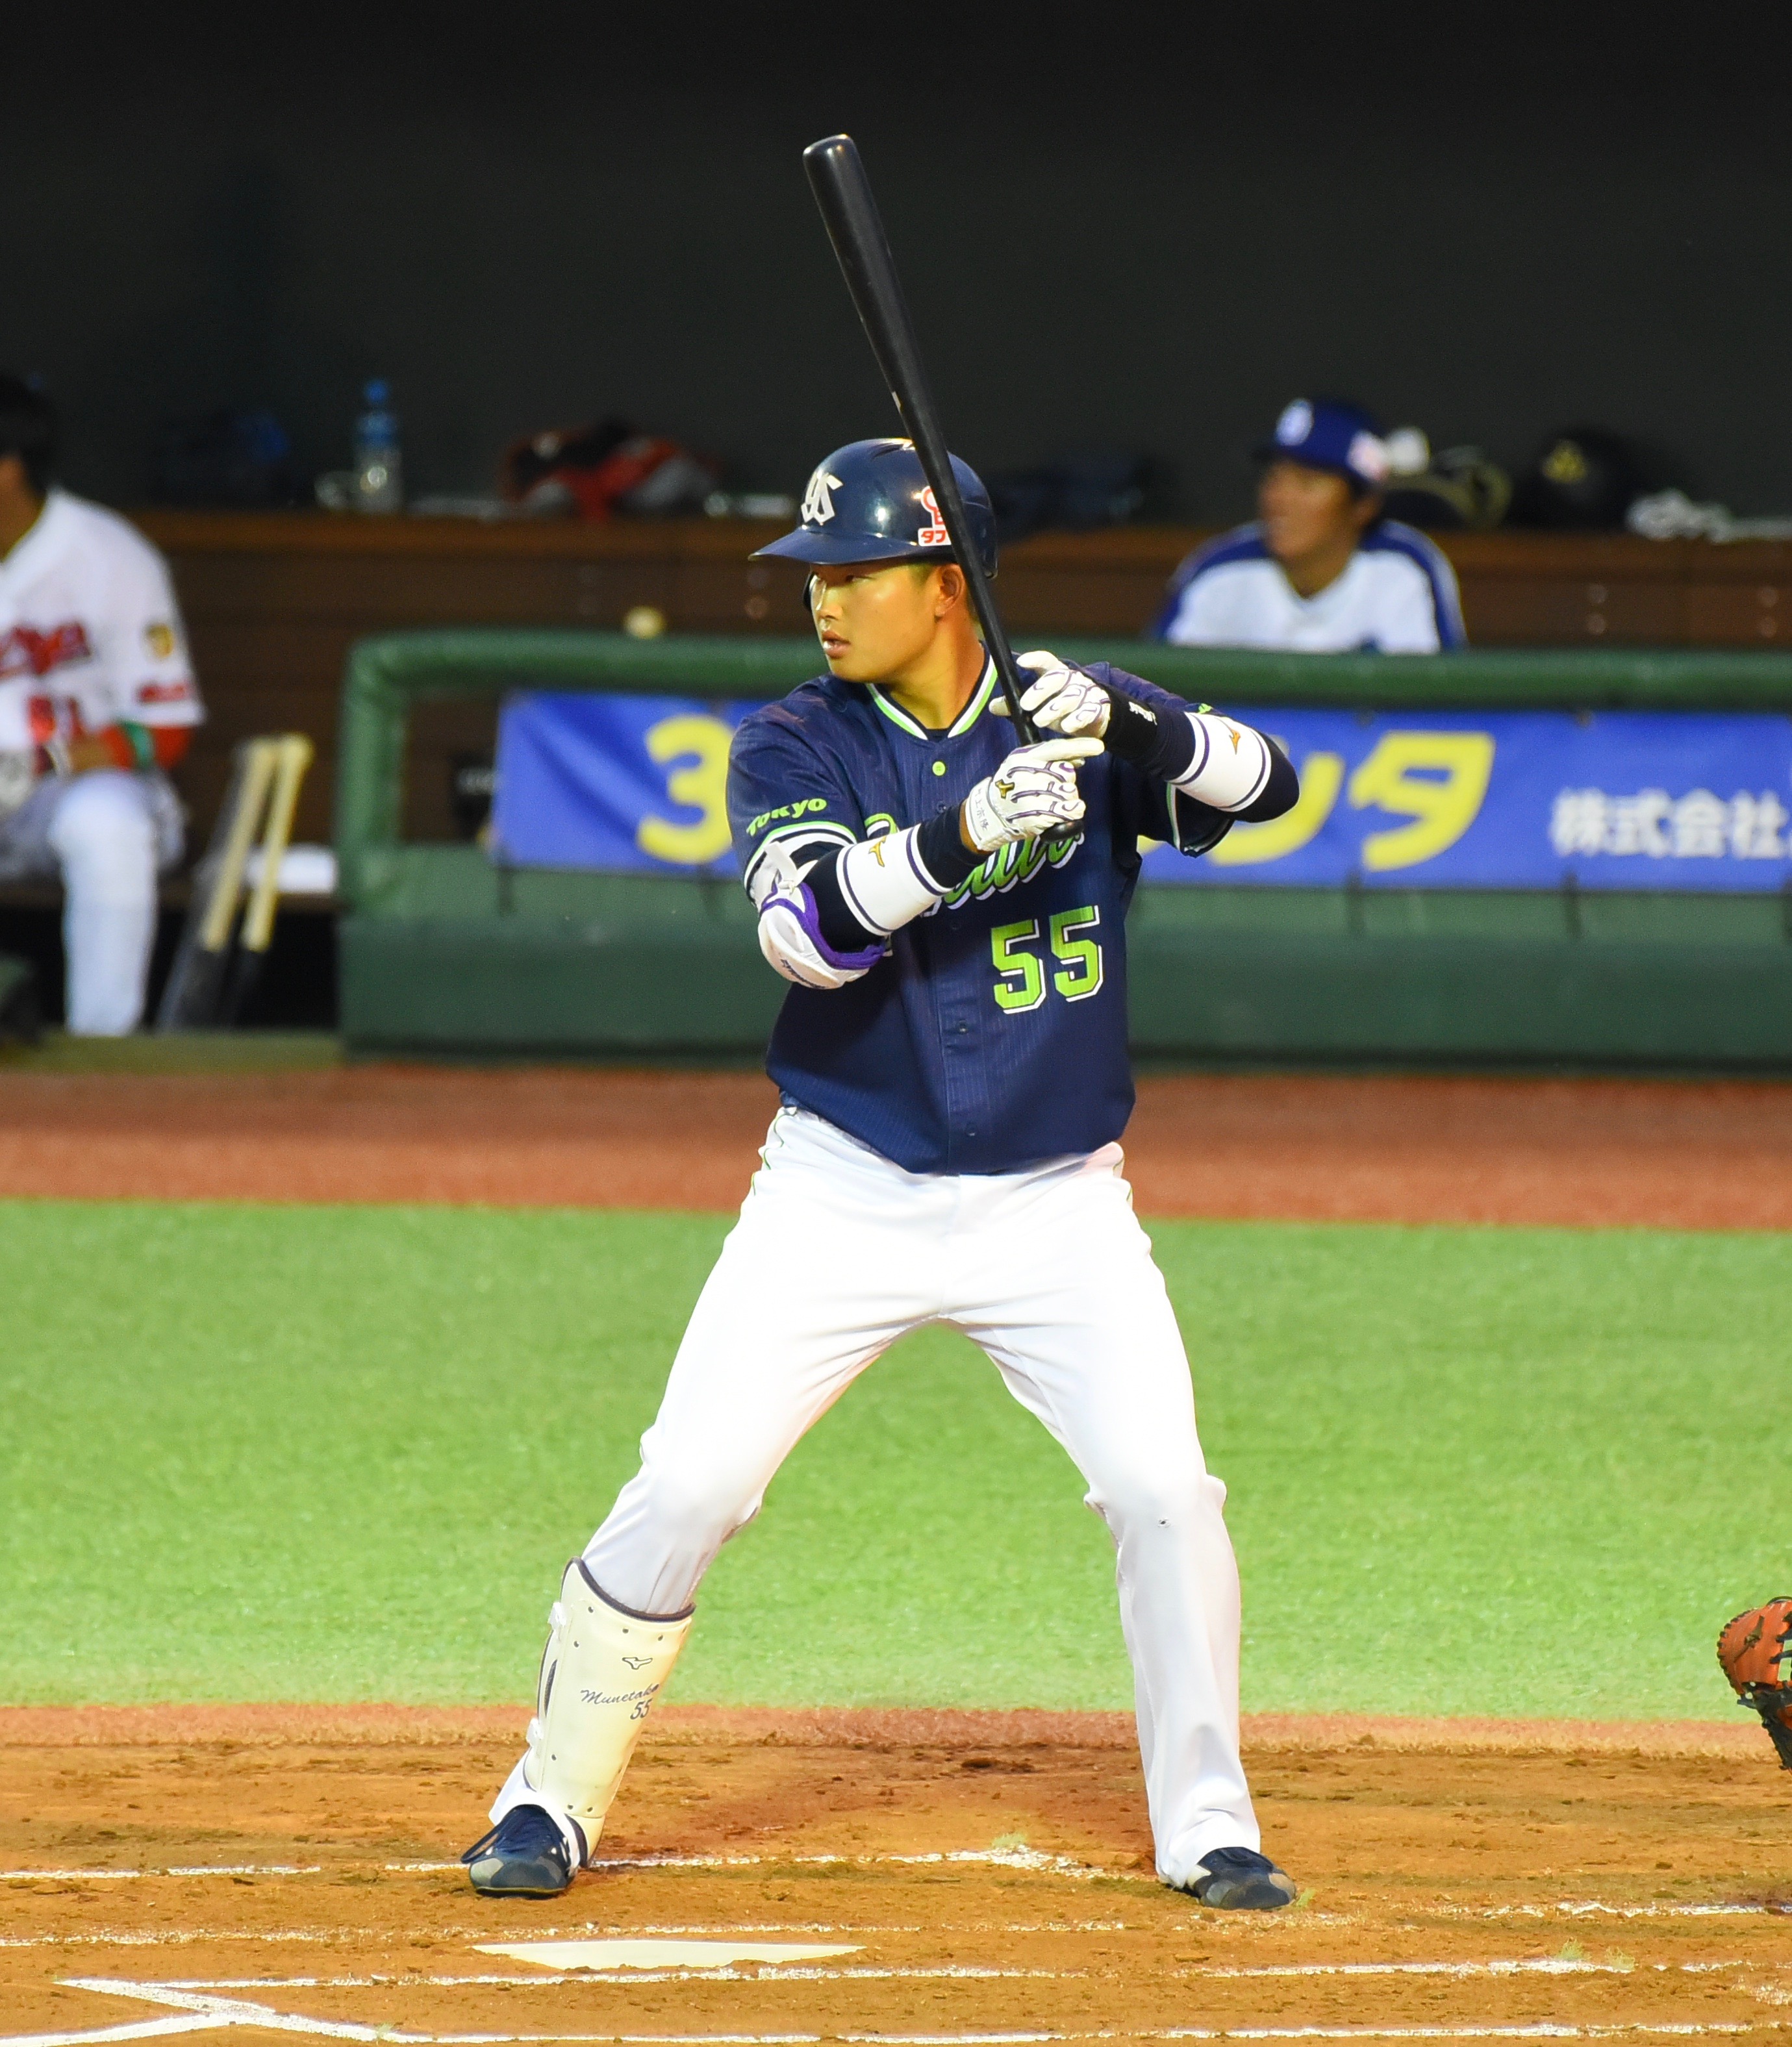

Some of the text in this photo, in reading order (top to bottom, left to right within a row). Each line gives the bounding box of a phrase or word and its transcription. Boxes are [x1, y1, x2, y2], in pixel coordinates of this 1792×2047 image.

[920, 529, 946, 544] タフ
[991, 905, 1104, 1014] 55
[629, 1697, 653, 1720] 55
